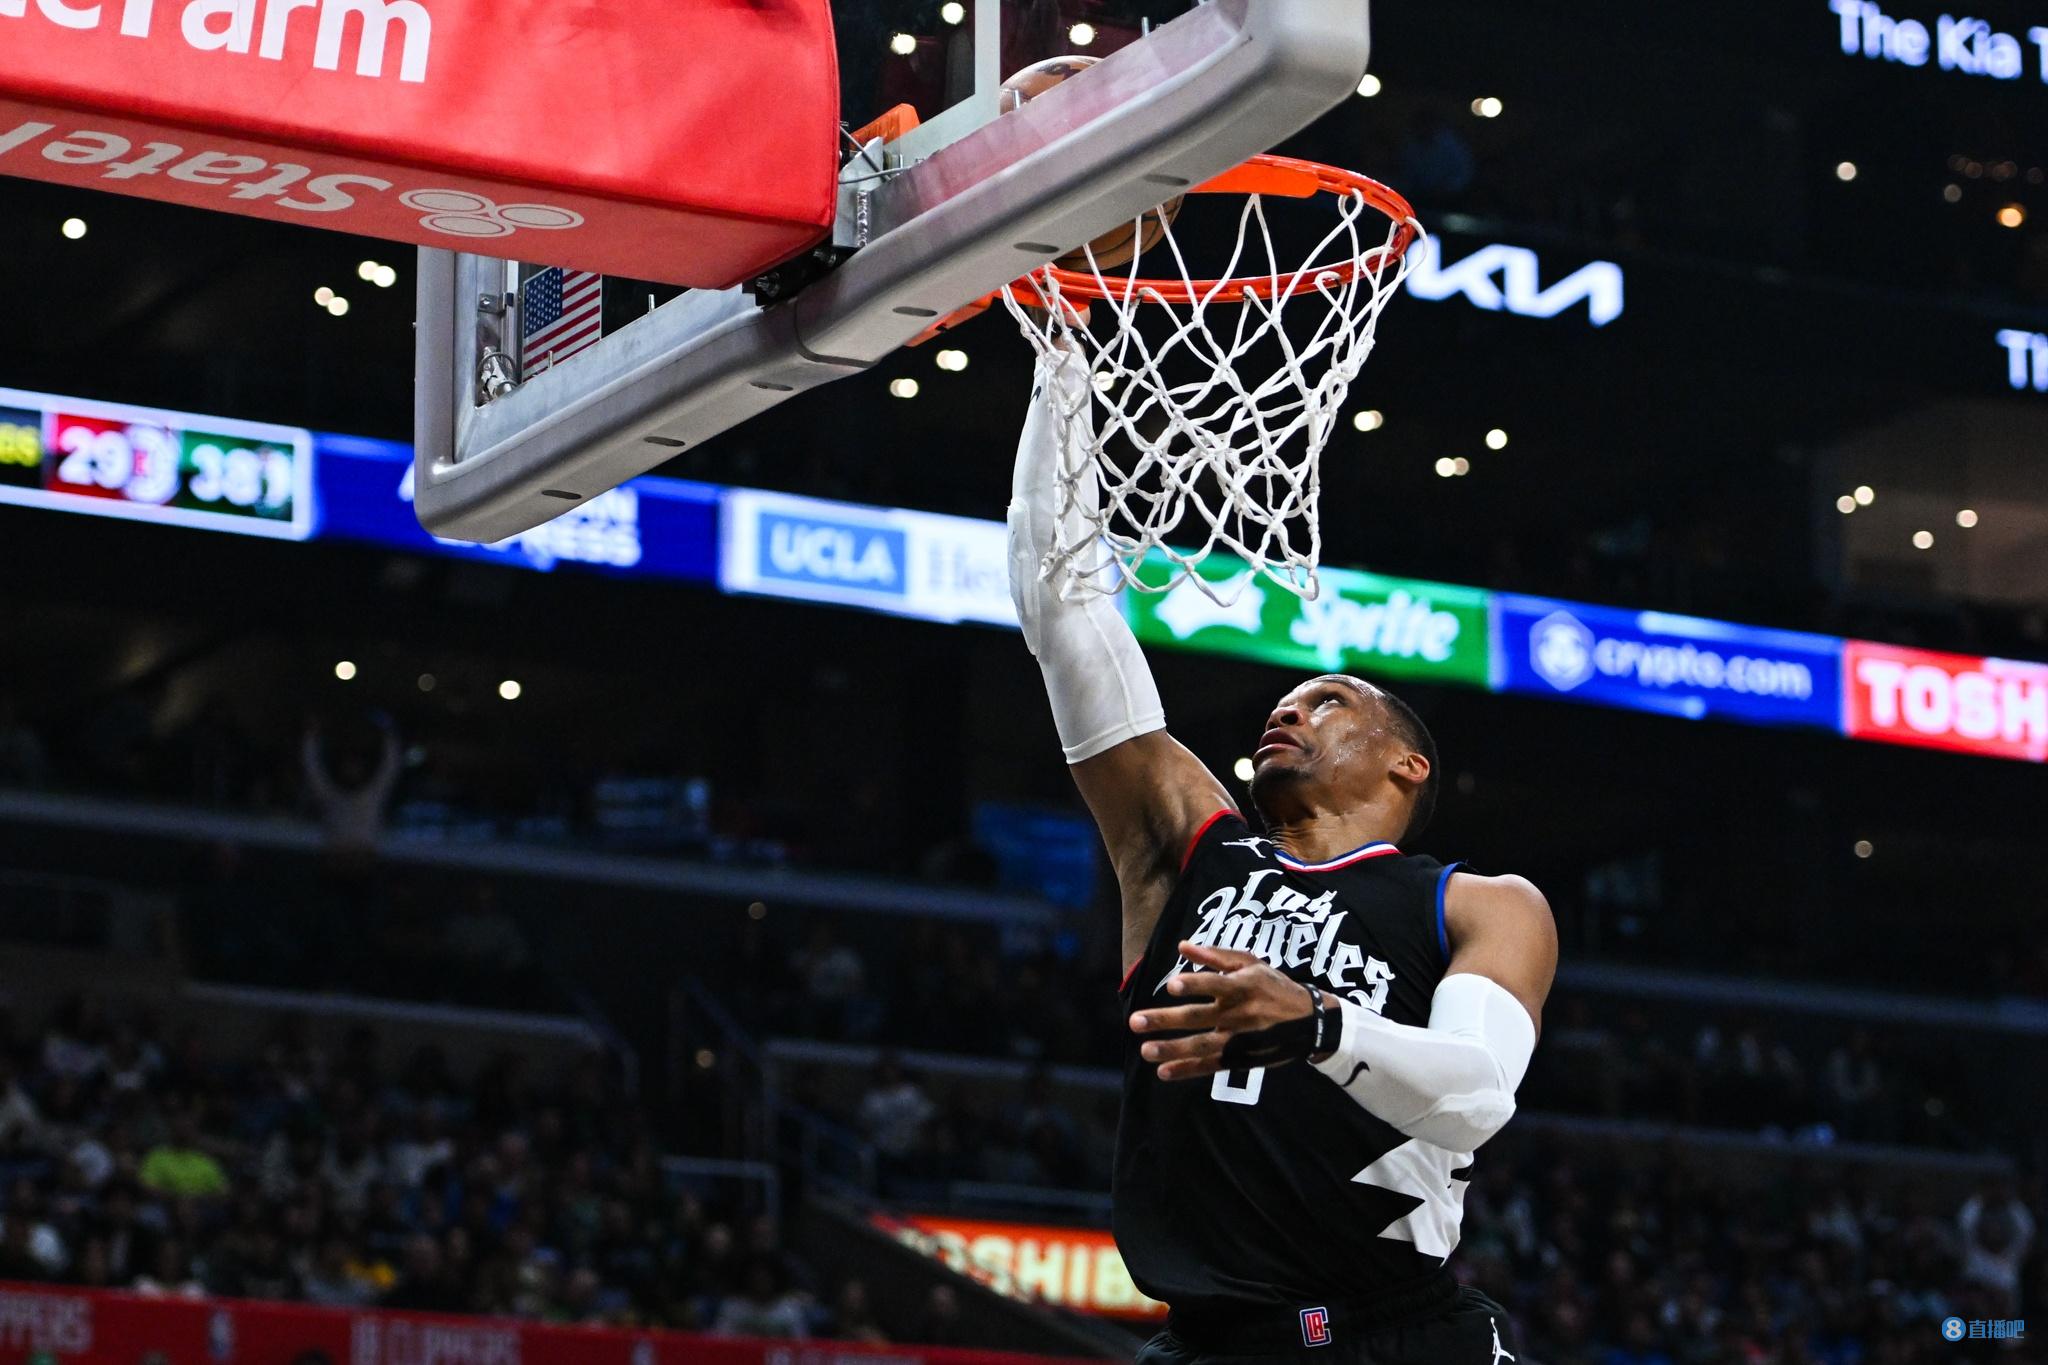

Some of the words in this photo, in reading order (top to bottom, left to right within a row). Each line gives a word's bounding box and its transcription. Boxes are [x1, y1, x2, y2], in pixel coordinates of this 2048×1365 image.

[1829, 0, 1930, 66] The
[1937, 14, 2022, 79] Kia
[769, 520, 897, 586] UCLA
[1289, 583, 1461, 672] Sprite
[1594, 637, 1813, 701] crypto.com
[1857, 658, 2048, 743] TOSH
[1229, 869, 1337, 923] Los
[1153, 886, 1396, 1016] Angeles
